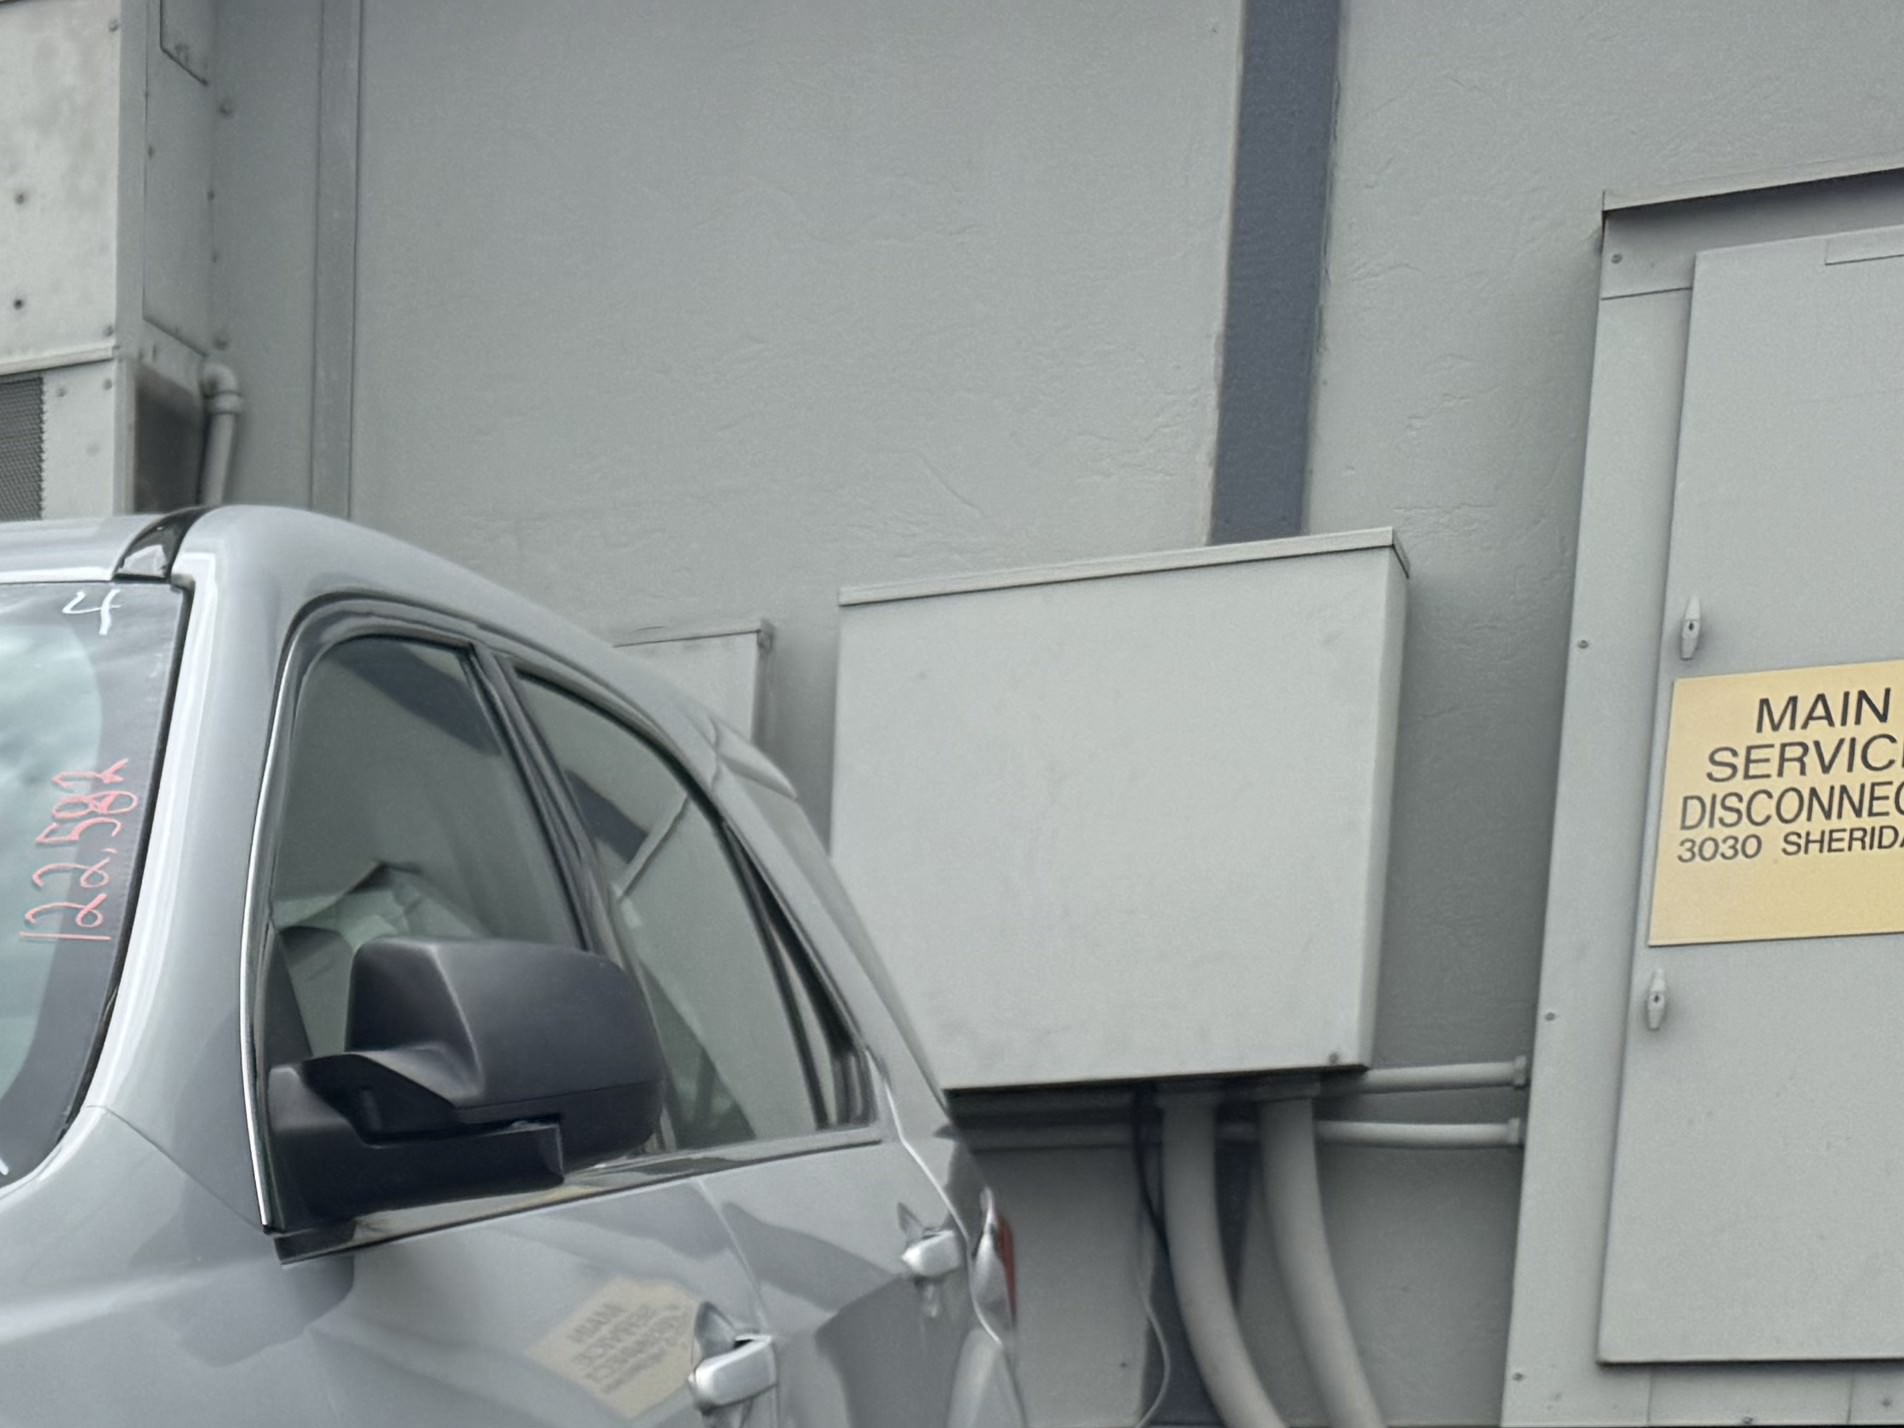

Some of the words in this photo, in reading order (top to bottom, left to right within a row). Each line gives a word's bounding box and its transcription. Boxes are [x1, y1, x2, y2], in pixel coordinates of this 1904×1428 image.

[61, 588, 122, 636] 4
[1755, 686, 1892, 734] MAIN
[1705, 732, 1904, 784] SERVIC
[1676, 832, 1763, 864] 3030
[1780, 824, 1904, 857] SHERID
